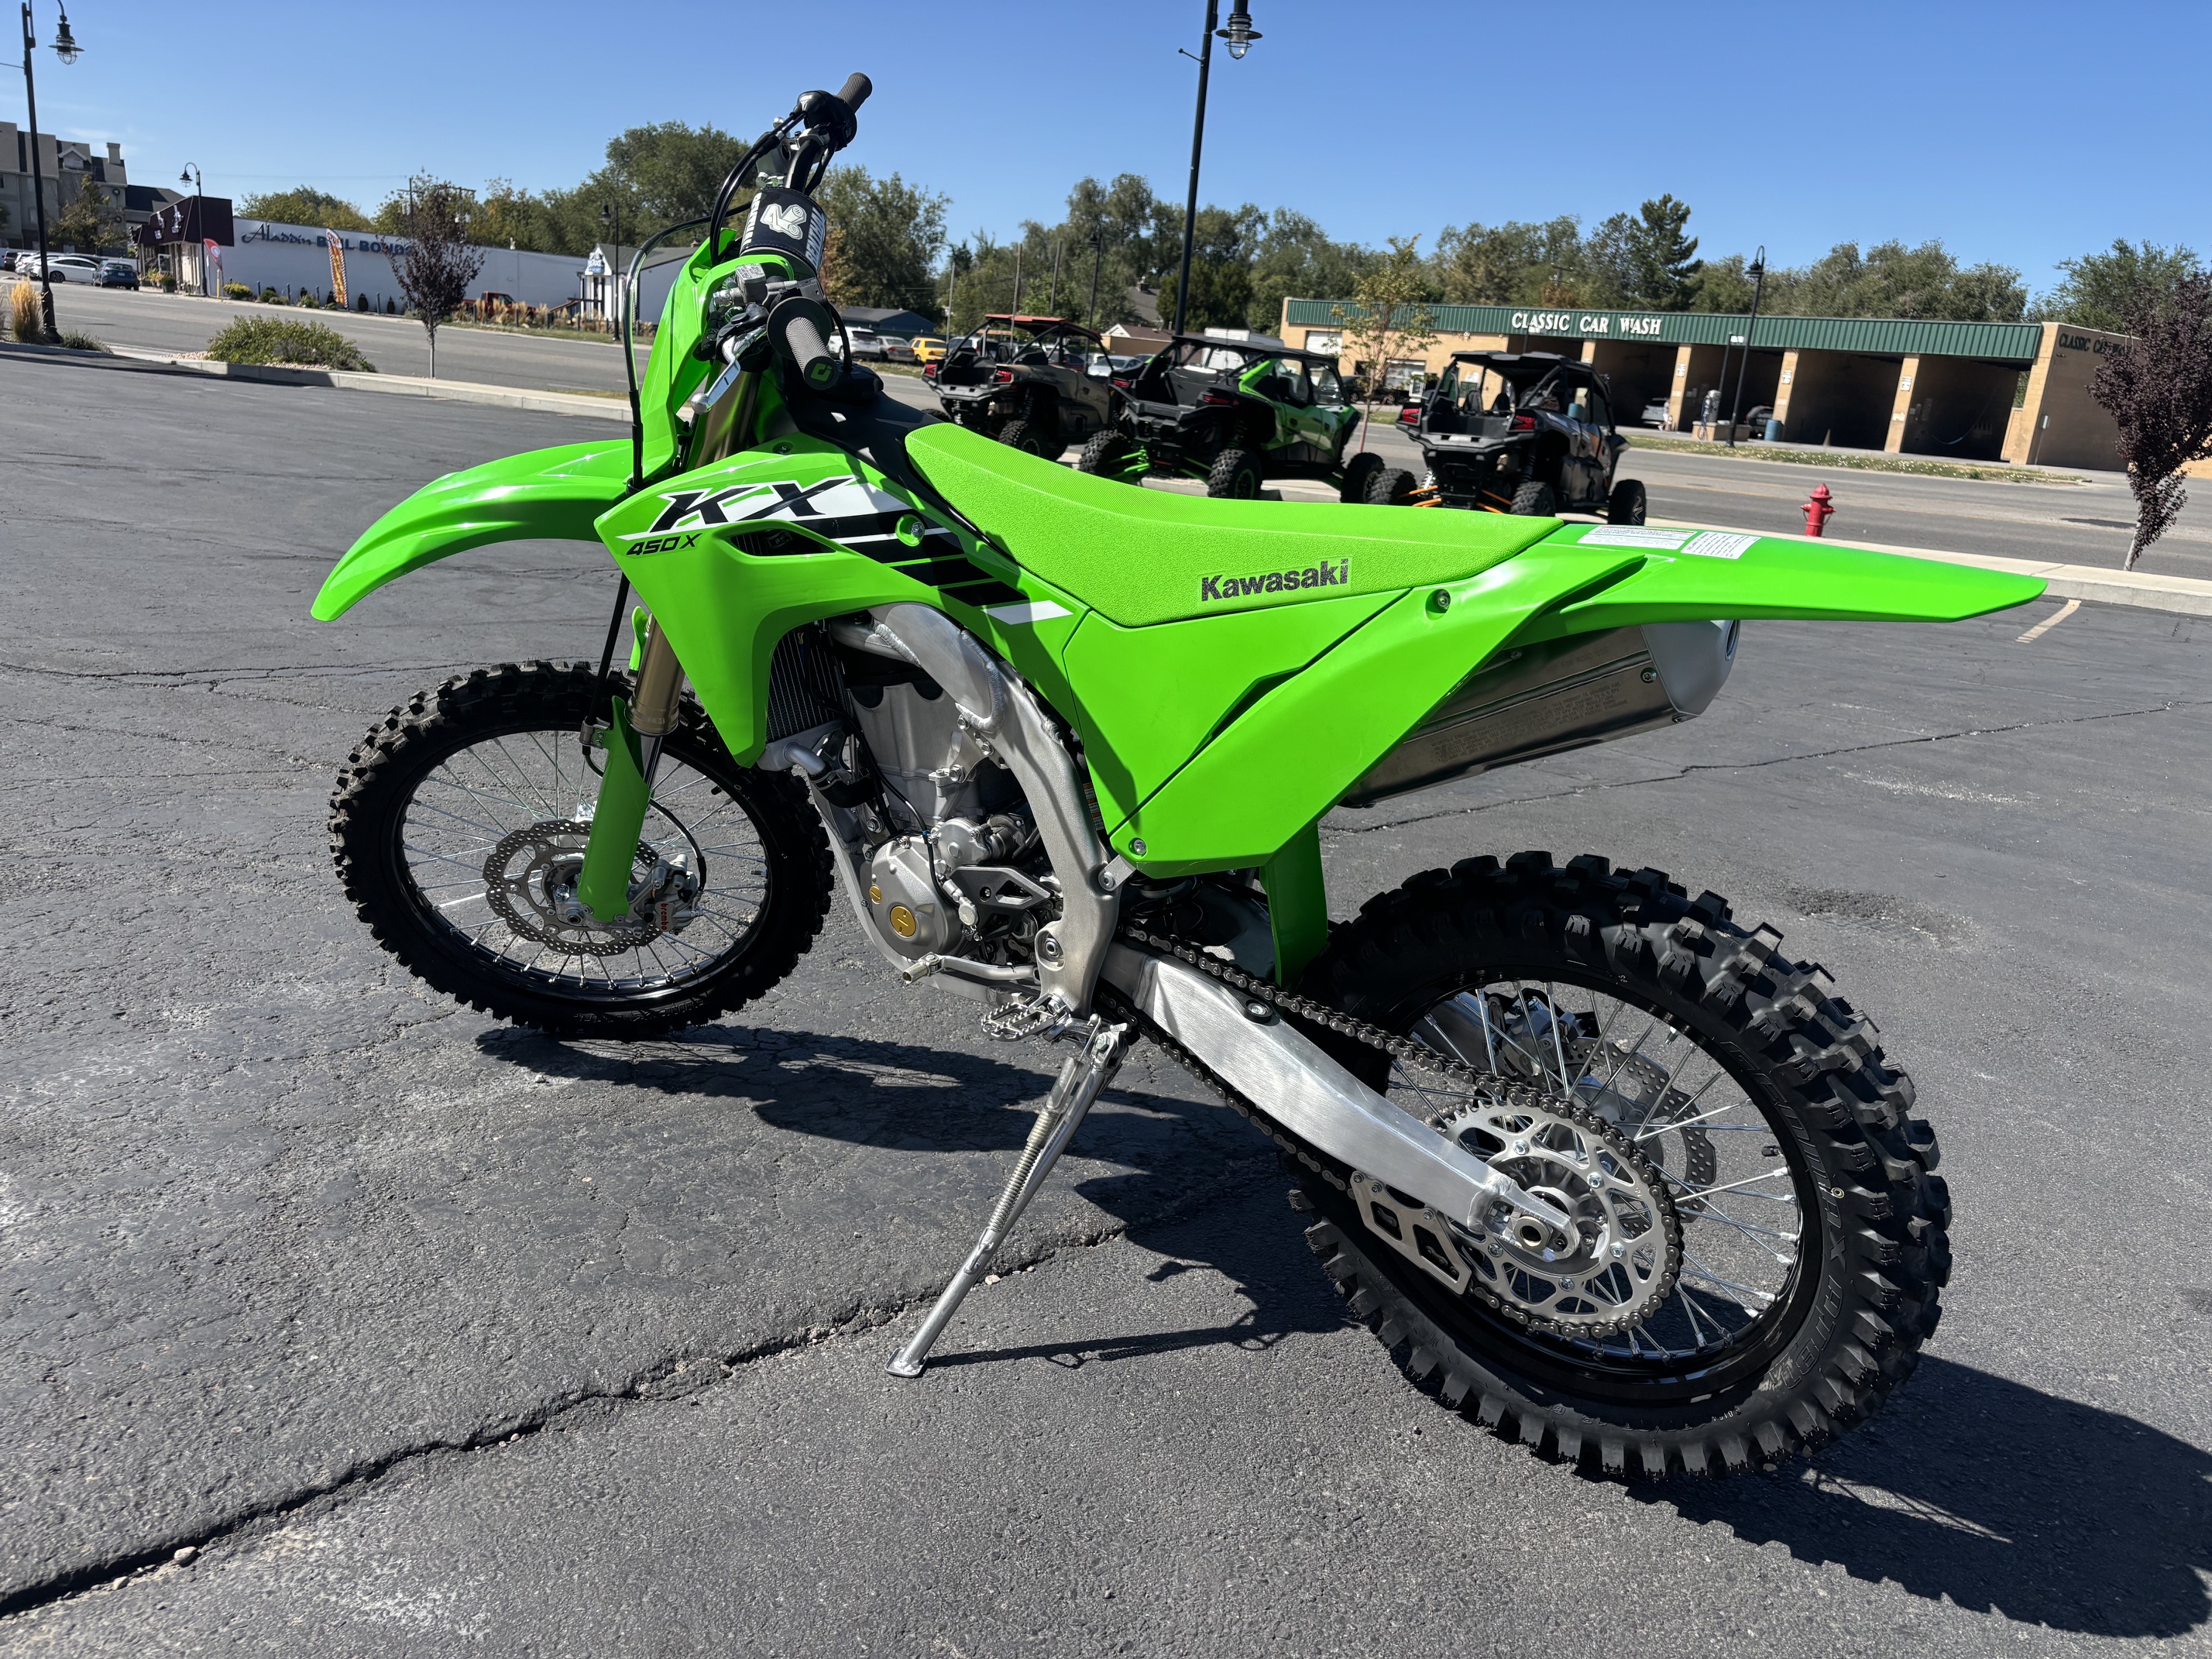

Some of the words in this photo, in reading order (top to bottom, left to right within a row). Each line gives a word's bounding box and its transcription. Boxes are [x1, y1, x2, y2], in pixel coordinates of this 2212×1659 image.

[241, 222, 313, 246] Aladdin
[316, 235, 355, 250] BIL
[805, 206, 826, 269] RENTHAL
[1511, 311, 1571, 331] CLASSIC
[1579, 315, 1610, 334] CAR
[1620, 318, 1662, 335] WASH
[2058, 333, 2090, 352] CLASSIC
[647, 476, 855, 534] KX
[626, 532, 703, 556] 450X
[1201, 558, 1349, 602] Kawasaki
[661, 903, 669, 930] brembo
